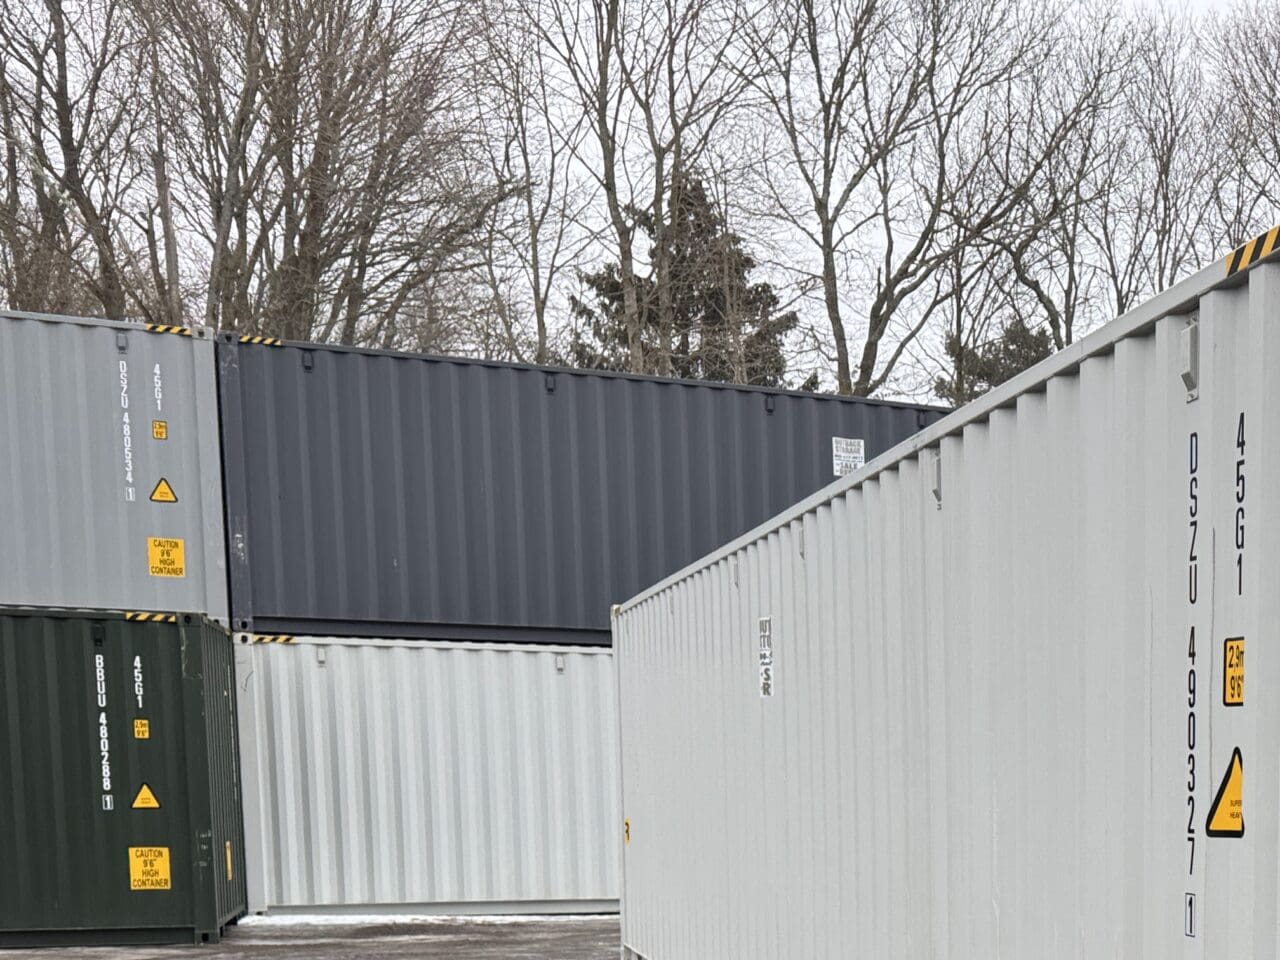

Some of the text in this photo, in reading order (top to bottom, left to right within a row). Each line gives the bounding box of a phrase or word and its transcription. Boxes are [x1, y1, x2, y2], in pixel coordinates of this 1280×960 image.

[120, 360, 129, 409] DSZU
[153, 363, 162, 411] 45G1
[123, 412, 133, 483] 480534
[1189, 432, 1198, 604] DSZU
[1235, 412, 1246, 596] 45G1
[153, 539, 179, 549] CAUTION
[150, 566, 183, 575] CONTAINER
[95, 654, 107, 707] BBUU
[133, 655, 143, 708] 45G1
[99, 712, 111, 791] 480288
[1187, 625, 1196, 875] 490327
[135, 849, 163, 858] CAUTION
[142, 869, 159, 877] HIGH
[132, 879, 169, 888] CONTAINER
